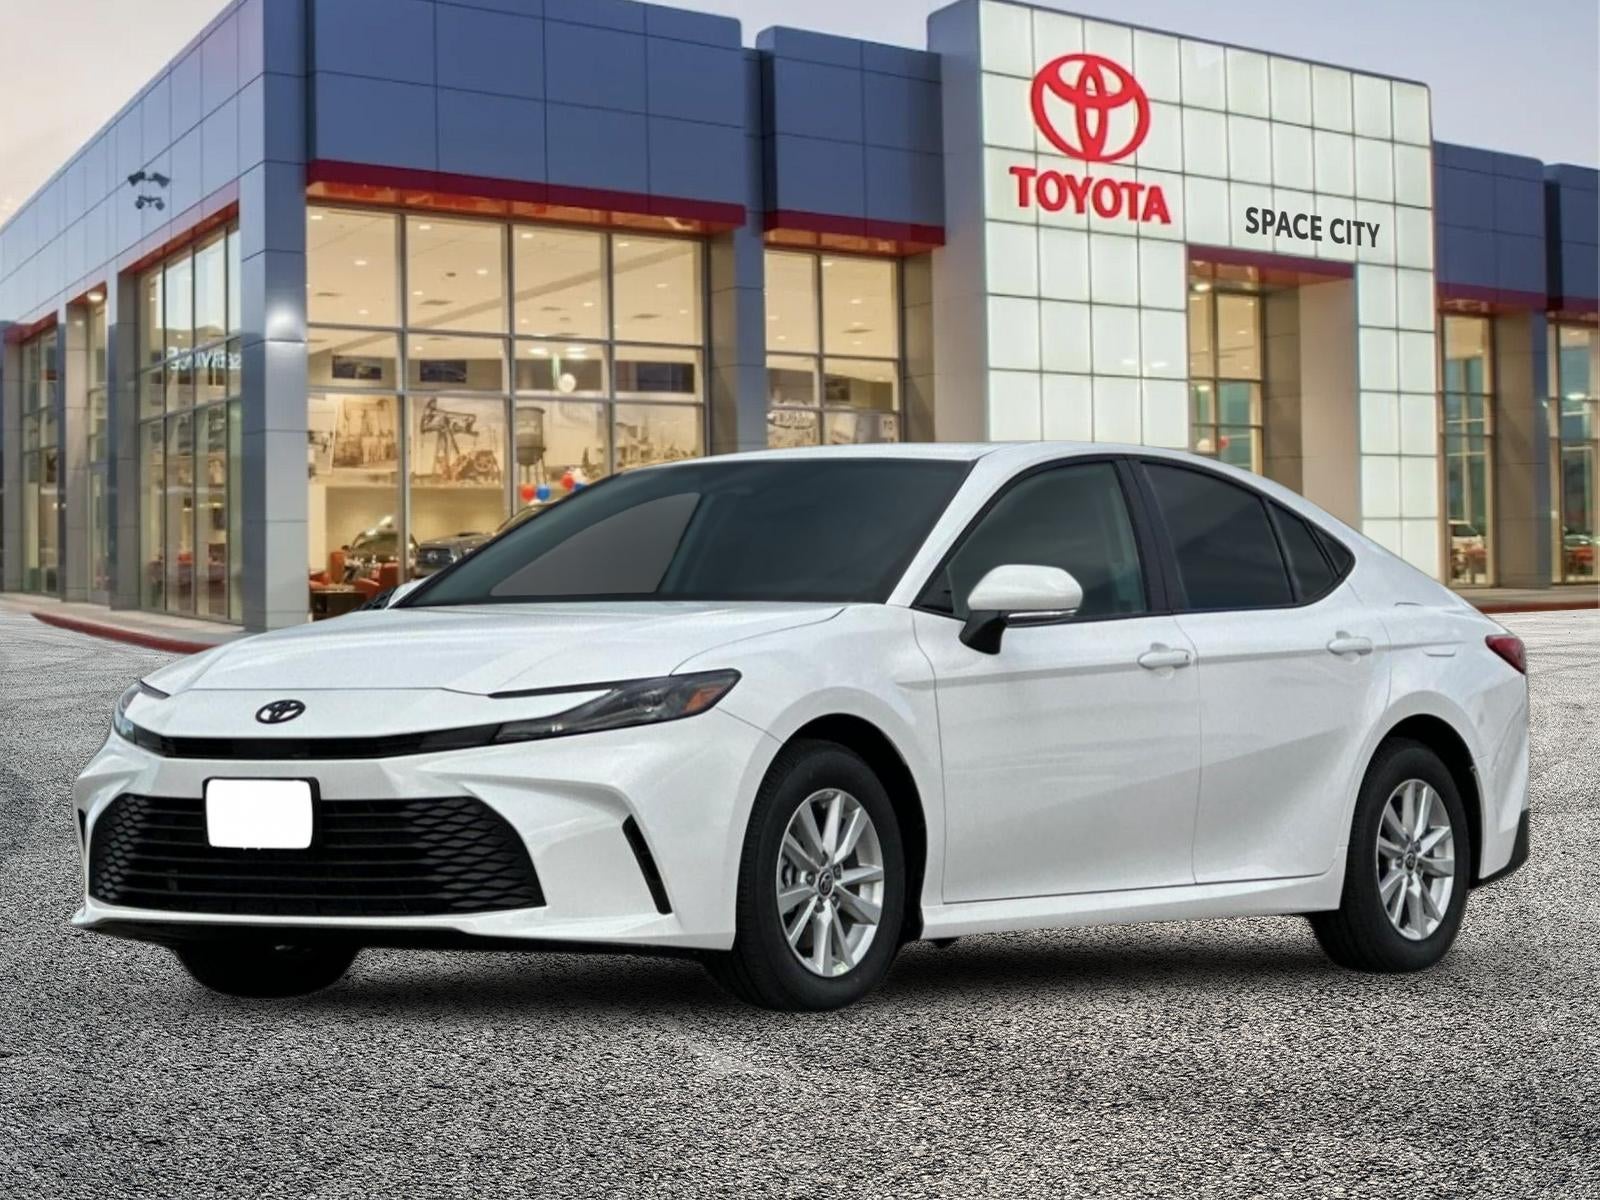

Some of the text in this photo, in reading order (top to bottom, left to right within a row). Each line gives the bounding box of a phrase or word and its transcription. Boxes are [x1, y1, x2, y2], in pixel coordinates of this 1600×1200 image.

[1009, 165, 1171, 224] TOYOTA
[1244, 206, 1381, 248] SPACE CITY
